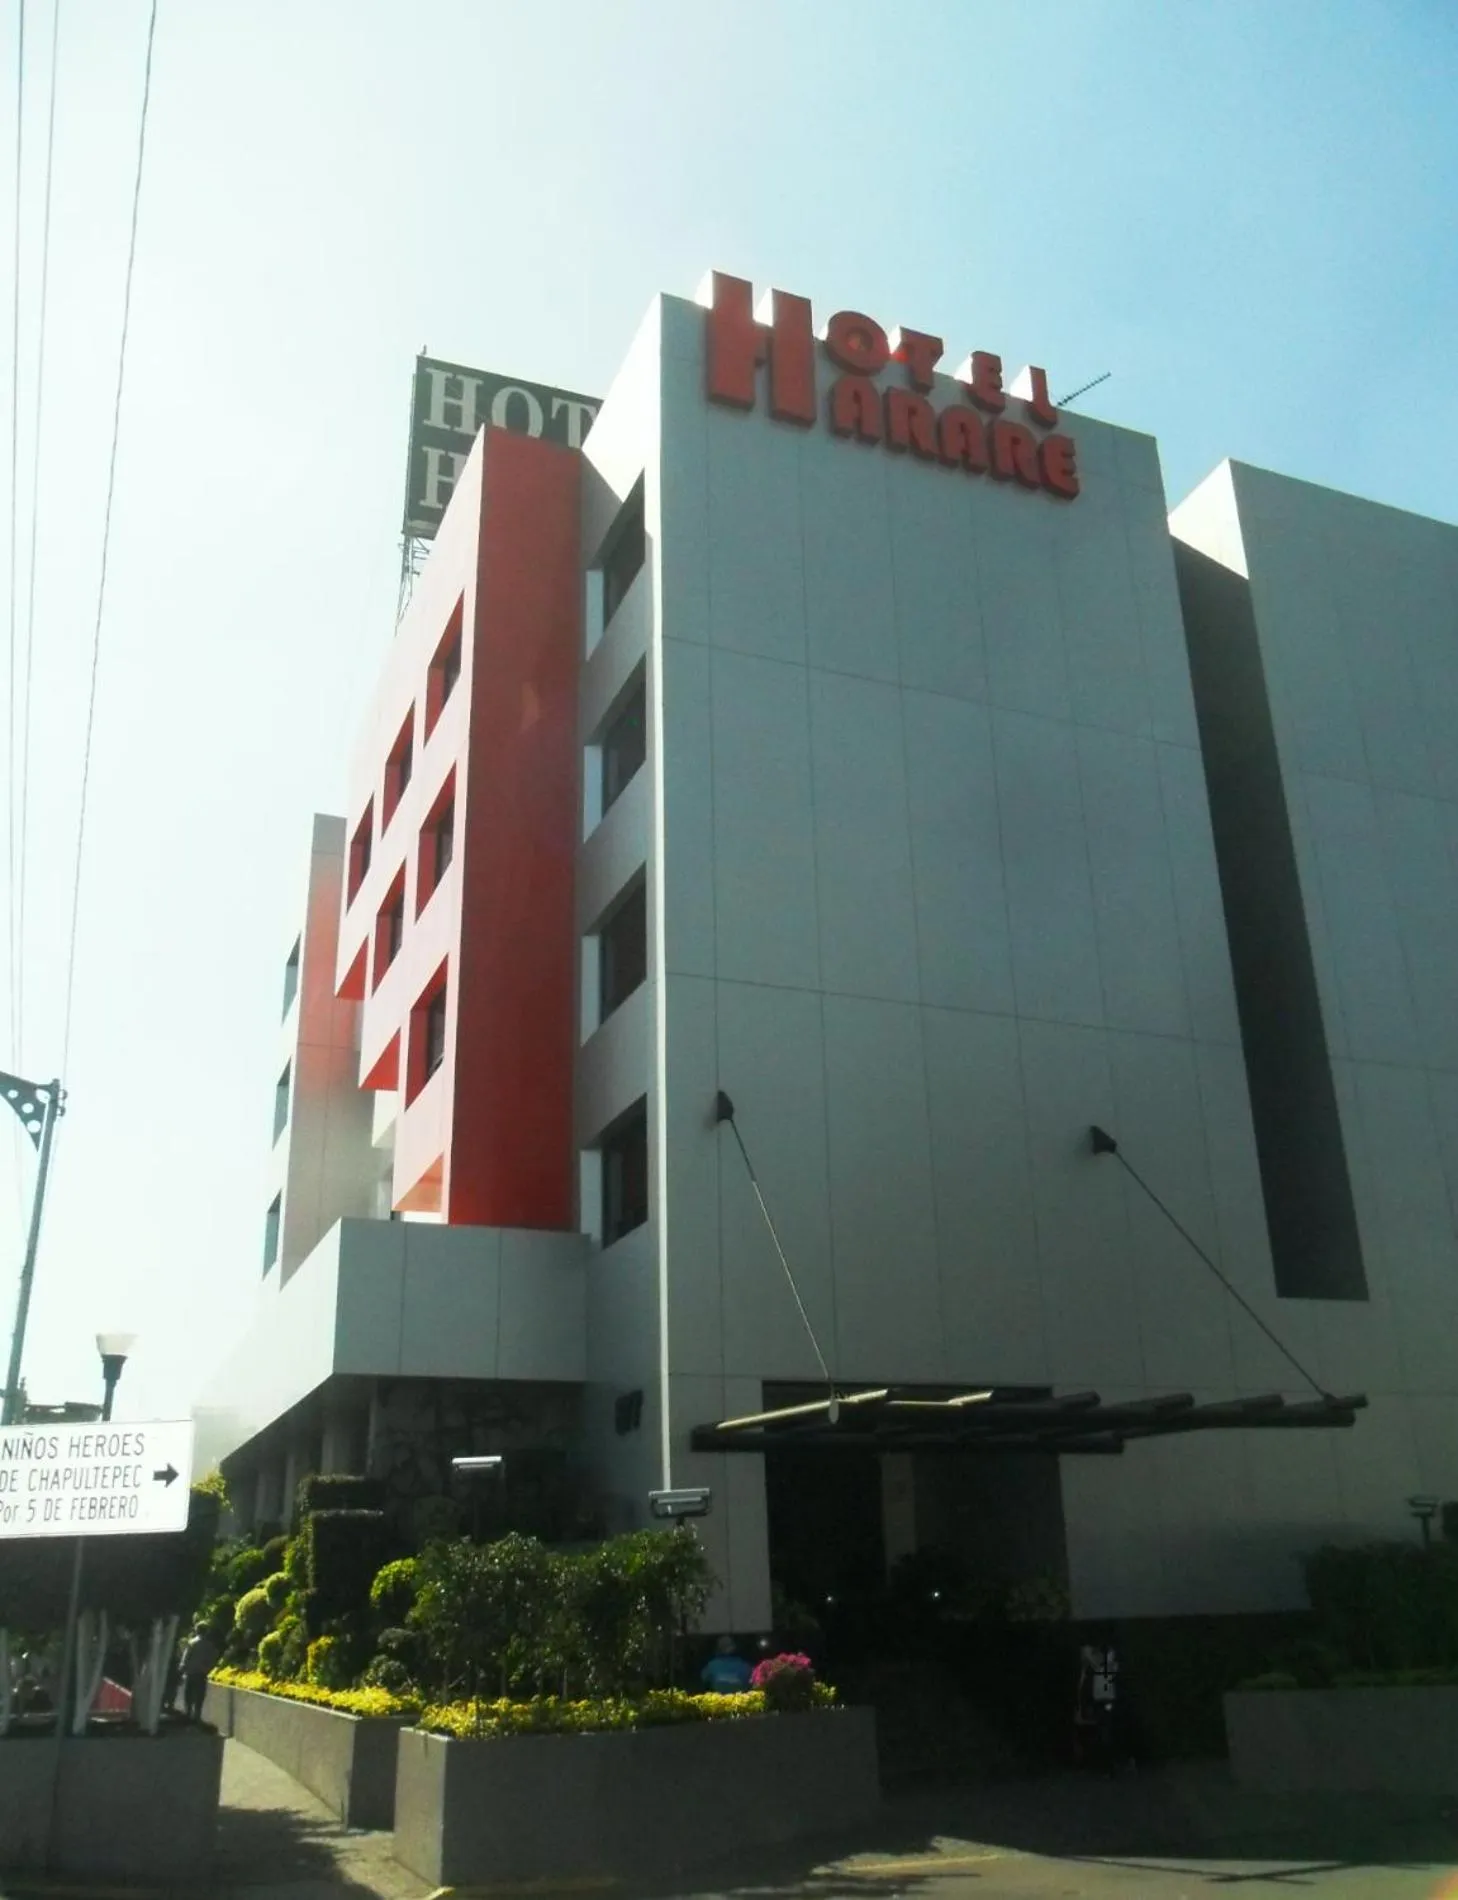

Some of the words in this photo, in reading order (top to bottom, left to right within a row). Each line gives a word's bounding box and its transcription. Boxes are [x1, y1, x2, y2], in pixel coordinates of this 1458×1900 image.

[706, 269, 1058, 429] HOTEL
[1, 1432, 59, 1460] NIÑOS
[68, 1433, 146, 1458] HEROES
[0, 1470, 18, 1493] DE
[28, 1464, 143, 1492] CHAPULTEPEC
[26, 1499, 37, 1523] 5
[44, 1498, 63, 1522] DE
[70, 1494, 139, 1521] FEBRERO
